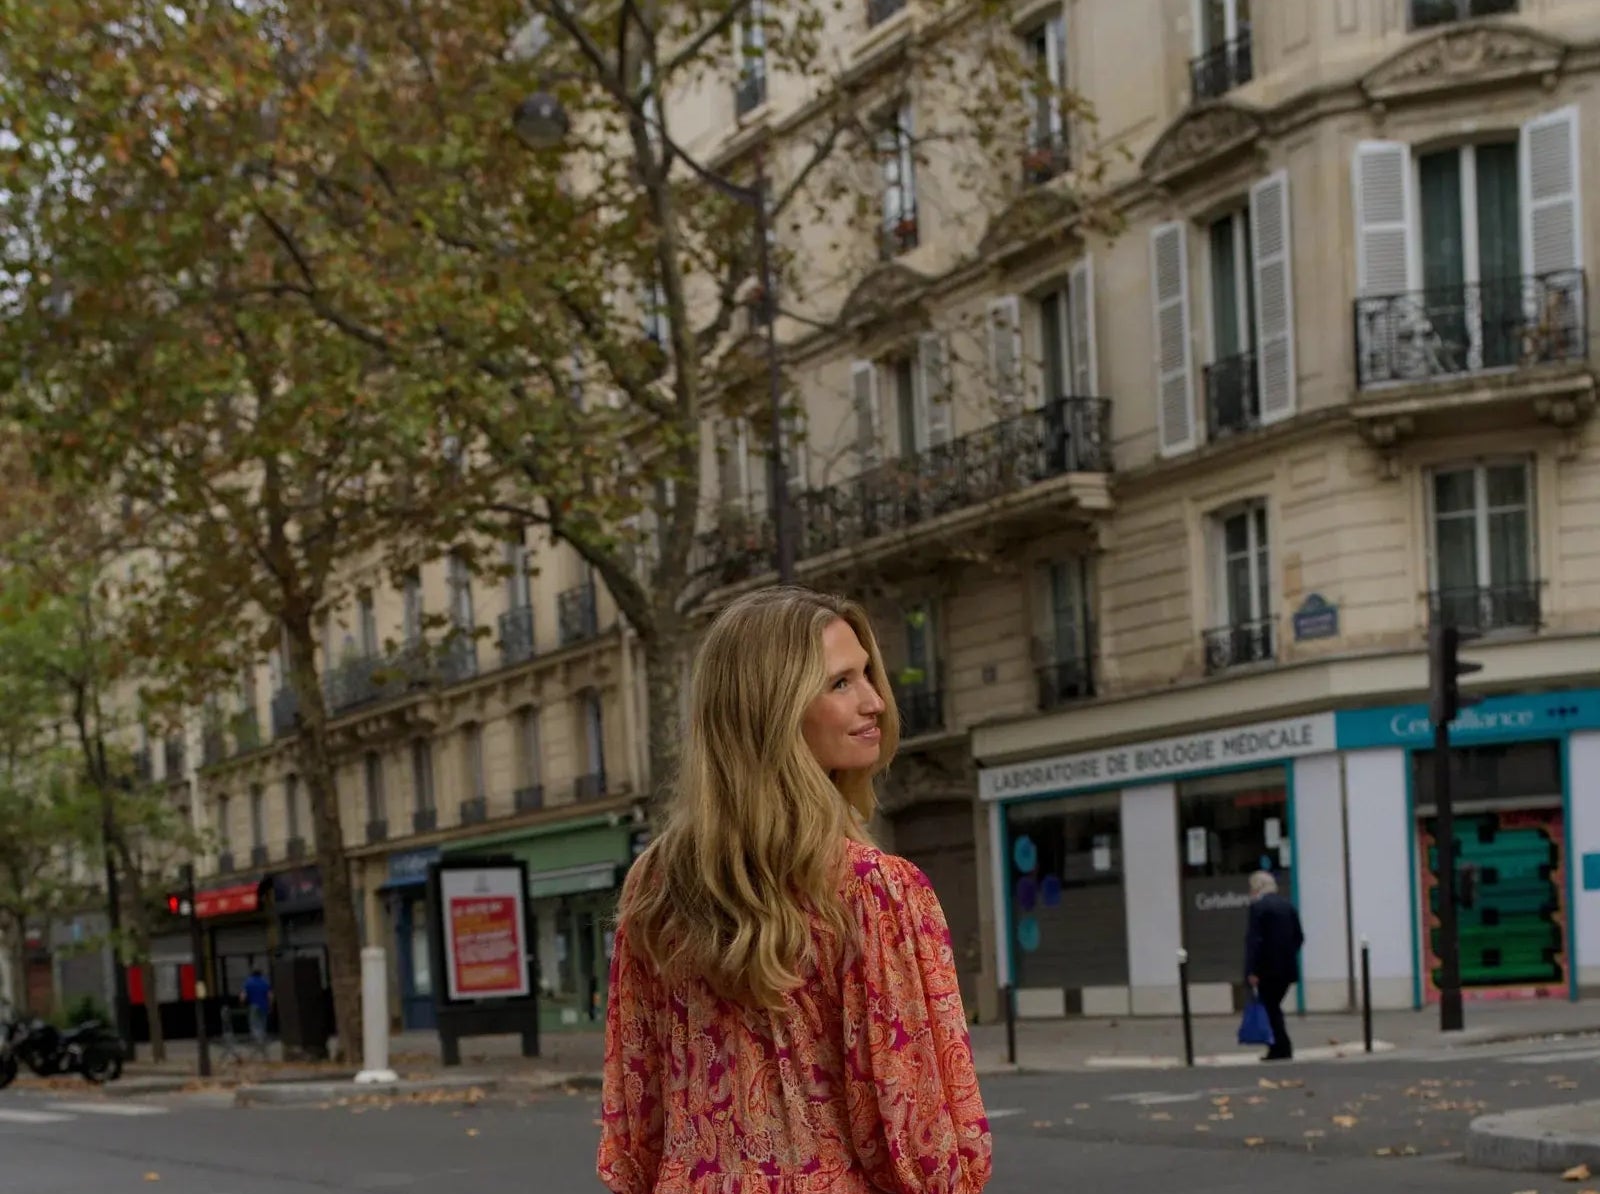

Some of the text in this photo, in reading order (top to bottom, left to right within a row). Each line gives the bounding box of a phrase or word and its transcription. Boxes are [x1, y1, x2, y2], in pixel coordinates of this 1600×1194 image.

[1390, 707, 1534, 737] Ceralliance
[992, 758, 1100, 792] LABORATOIRE
[1106, 753, 1128, 775] DE
[1135, 739, 1216, 771] BIOLOGIE
